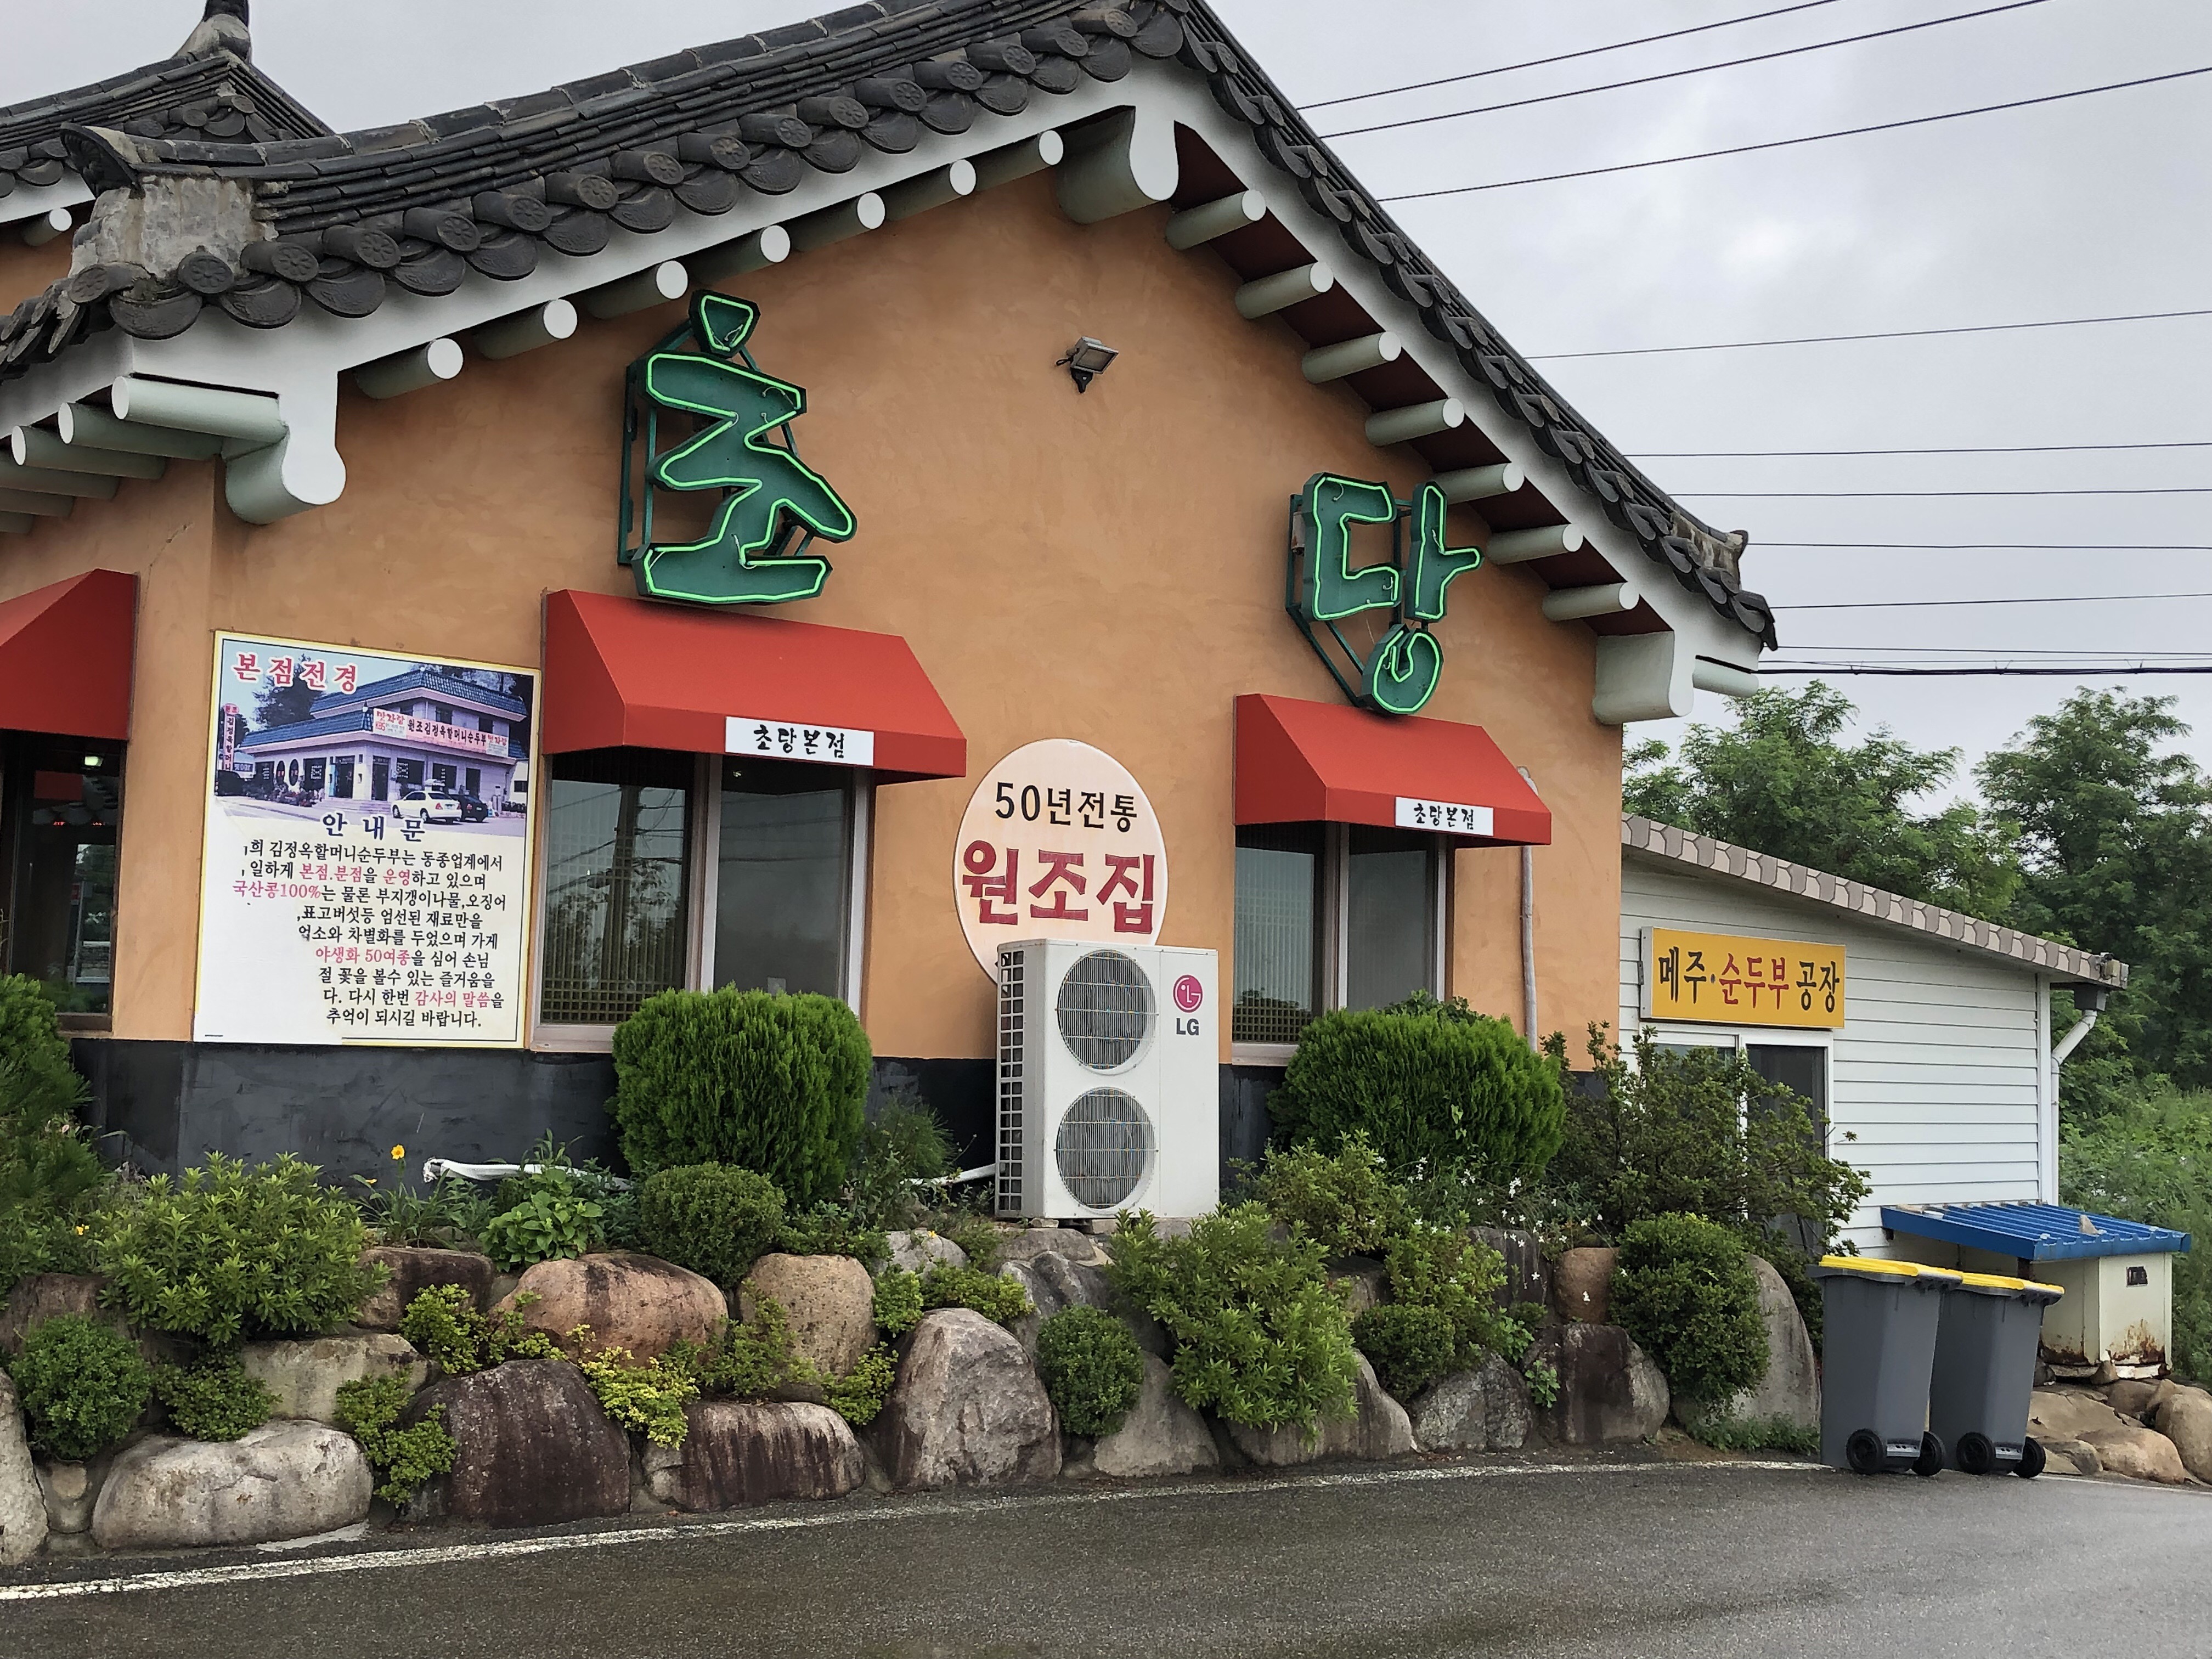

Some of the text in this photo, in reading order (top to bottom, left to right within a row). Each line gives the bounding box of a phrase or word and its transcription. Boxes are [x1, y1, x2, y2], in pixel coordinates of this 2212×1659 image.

[632, 289, 1485, 715] 초 당
[233, 653, 357, 692] 본점전경
[753, 724, 845, 759] 초당본점
[995, 781, 1138, 833] 50년전통
[1413, 803, 1474, 830] 초당본점
[269, 840, 416, 866] 김정옥할머니순두부는
[420, 850, 503, 872] 동종업계에서
[241, 859, 294, 880] 일하게
[382, 868, 440, 887] 운영하고
[446, 871, 486, 890] 있으며
[962, 839, 1155, 935] 원조집
[232, 880, 336, 902] 국산콩100%는
[341, 885, 371, 904] 물론
[381, 908, 421, 927] 엄선된
[425, 910, 483, 930] 재료만을
[298, 924, 498, 950] 업소와 차별화를 두었으며 가게
[315, 945, 489, 969] 야생화 50여종을 심어 손님
[318, 966, 495, 989] 절 꽃을 볼수 있는 즐거움을
[1796, 960, 1840, 1013] 공장
[323, 986, 505, 1009] 다. 다시 한번 감사의 말씀을
[326, 1007, 482, 1028] 추억이 되시길 바랍니다.
[1176, 1018, 1200, 1036] LG
